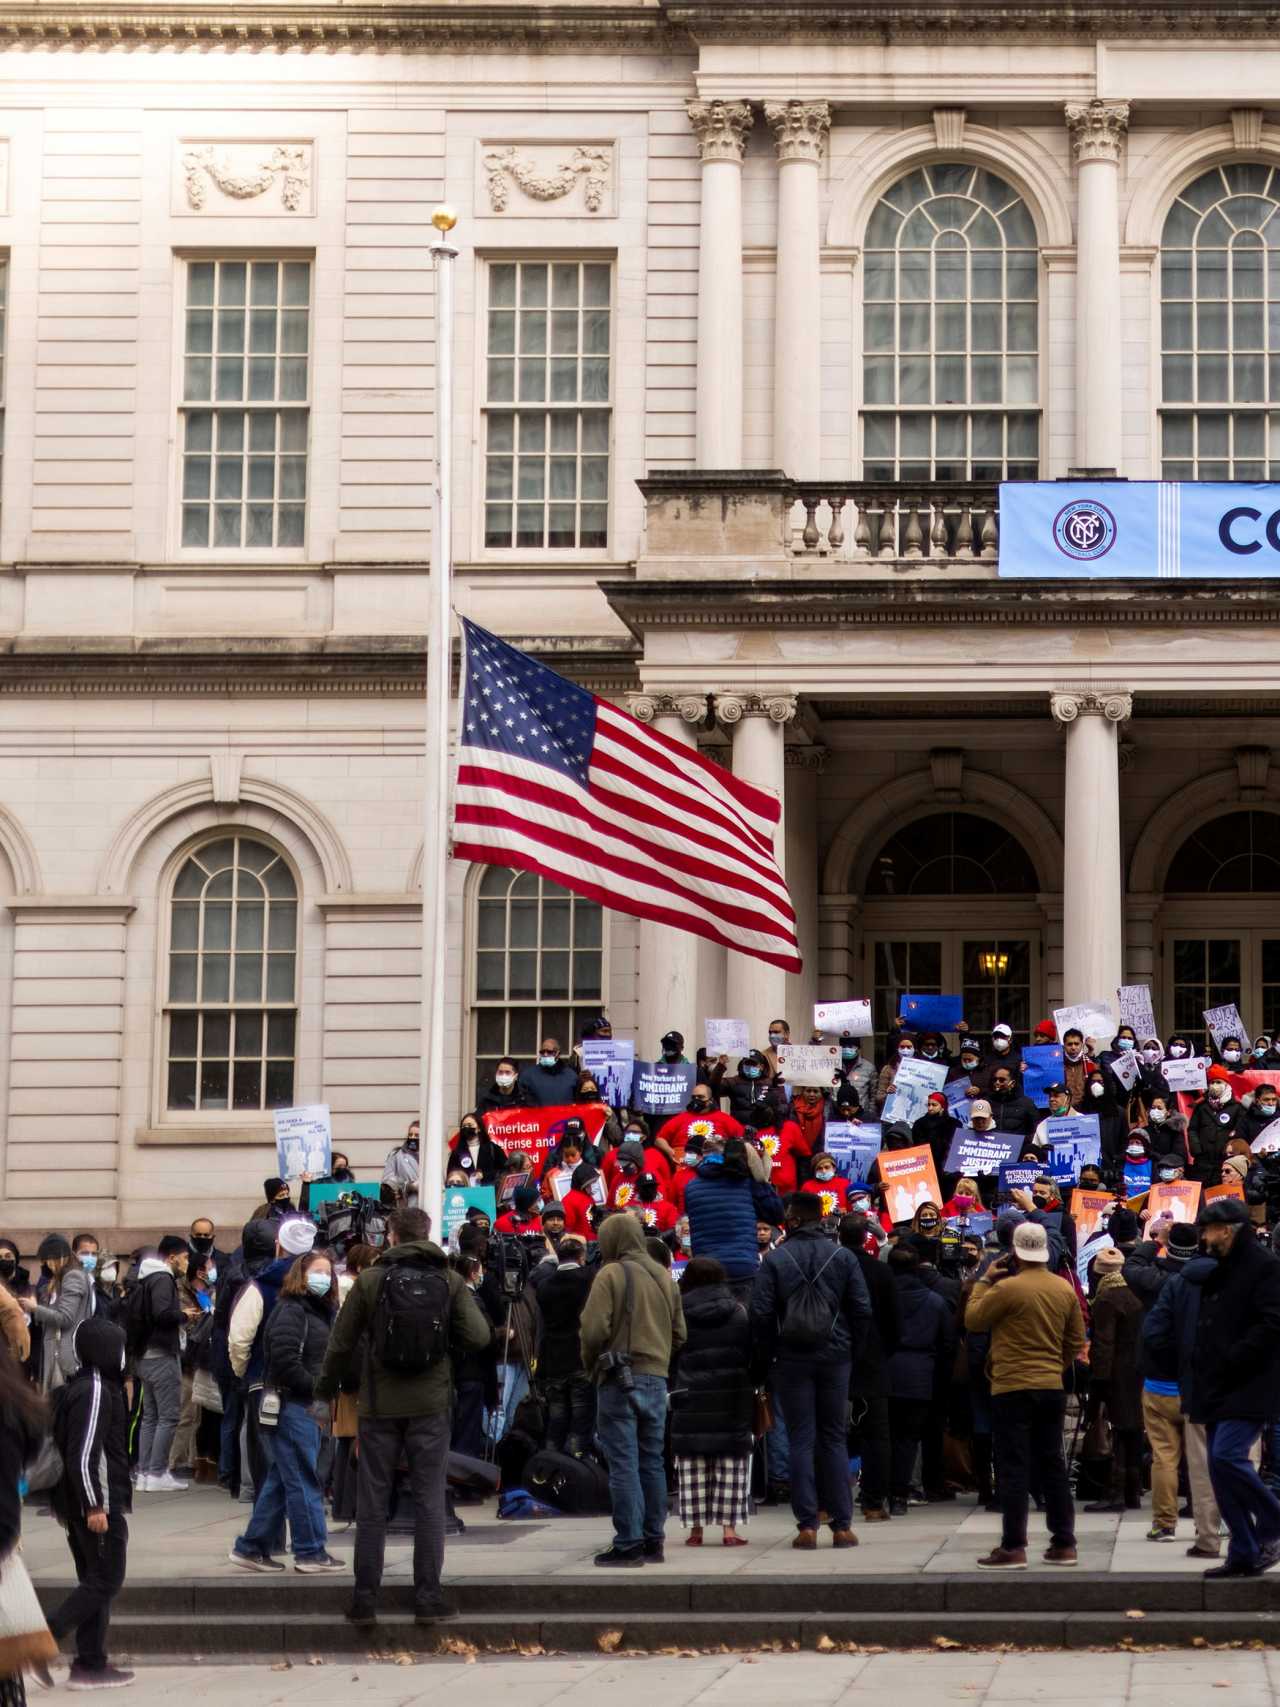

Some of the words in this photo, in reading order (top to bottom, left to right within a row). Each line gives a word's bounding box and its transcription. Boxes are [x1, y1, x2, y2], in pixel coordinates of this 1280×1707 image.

[639, 1080, 688, 1093] IMMIGRANT
[644, 1093, 681, 1104] JUSTICE
[487, 1121, 540, 1136] American
[491, 1137, 532, 1150] efense
[535, 1135, 556, 1148] and
[958, 1145, 1012, 1160] IMMIGRANT
[962, 1156, 1002, 1168] JUSTICE
